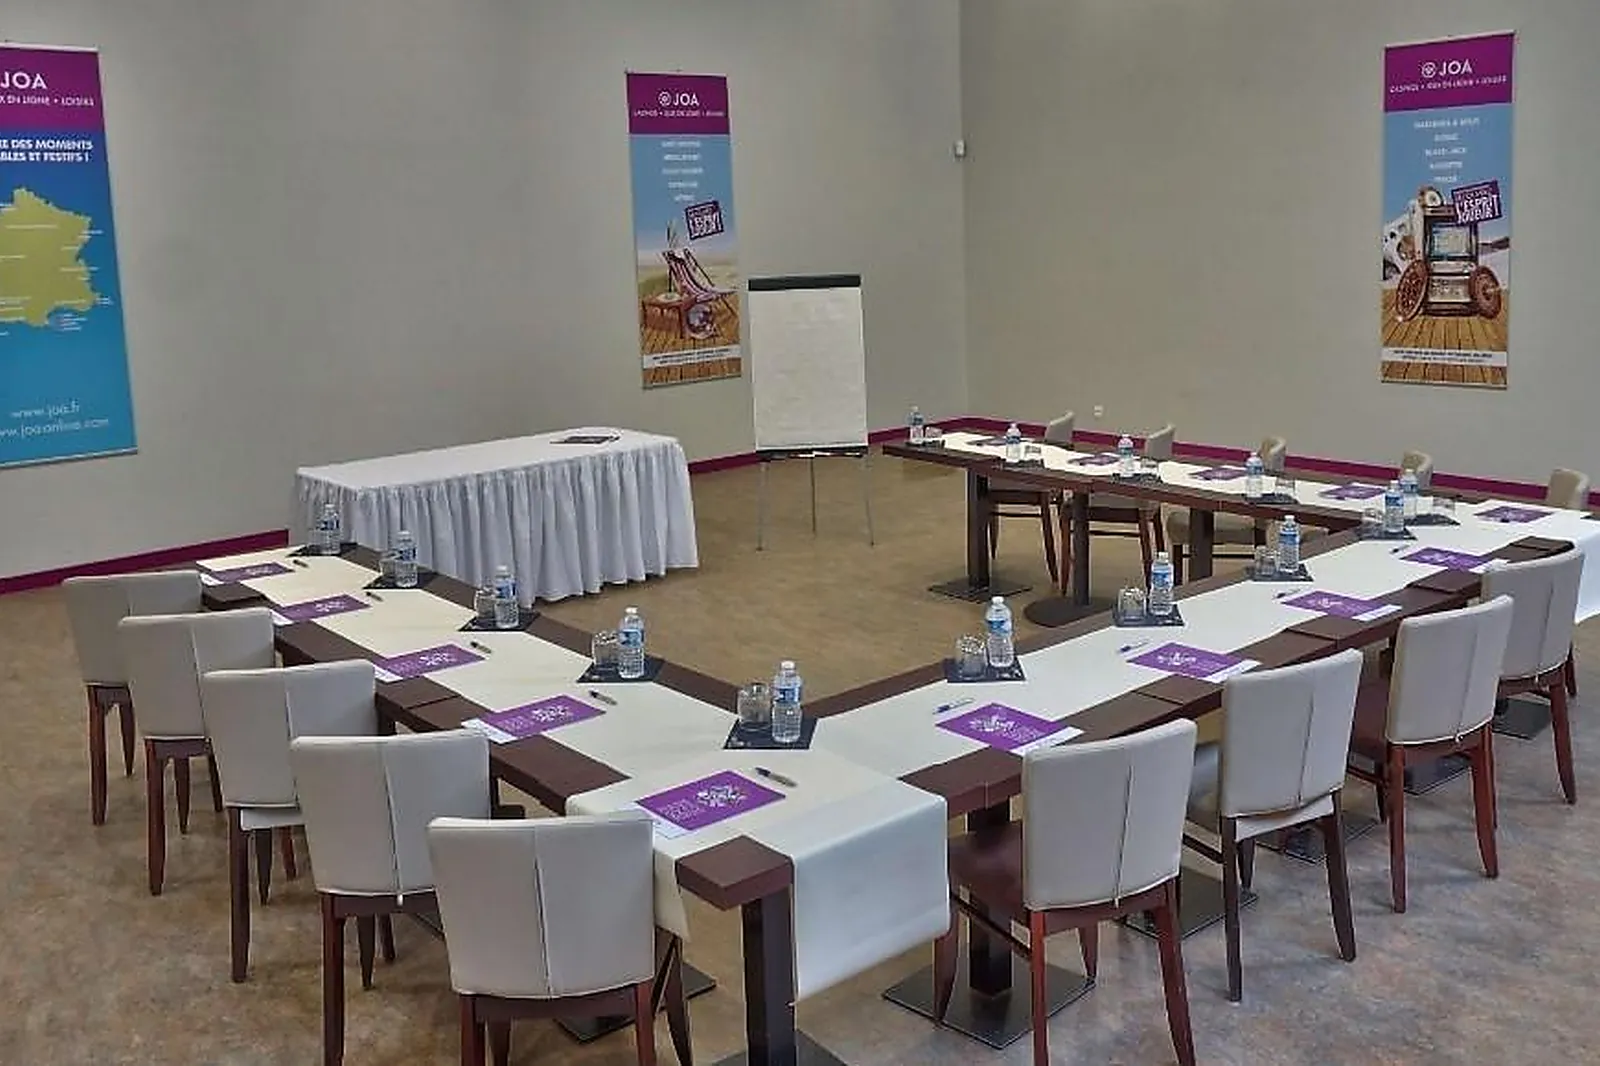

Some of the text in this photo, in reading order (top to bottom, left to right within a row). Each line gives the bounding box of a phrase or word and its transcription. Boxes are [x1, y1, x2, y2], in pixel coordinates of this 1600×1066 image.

[1439, 59, 1472, 76] JOA
[0, 71, 47, 89] JOA
[673, 93, 700, 106] JOA
[11, 139, 33, 149] DES
[35, 139, 94, 150] MOMENTS
